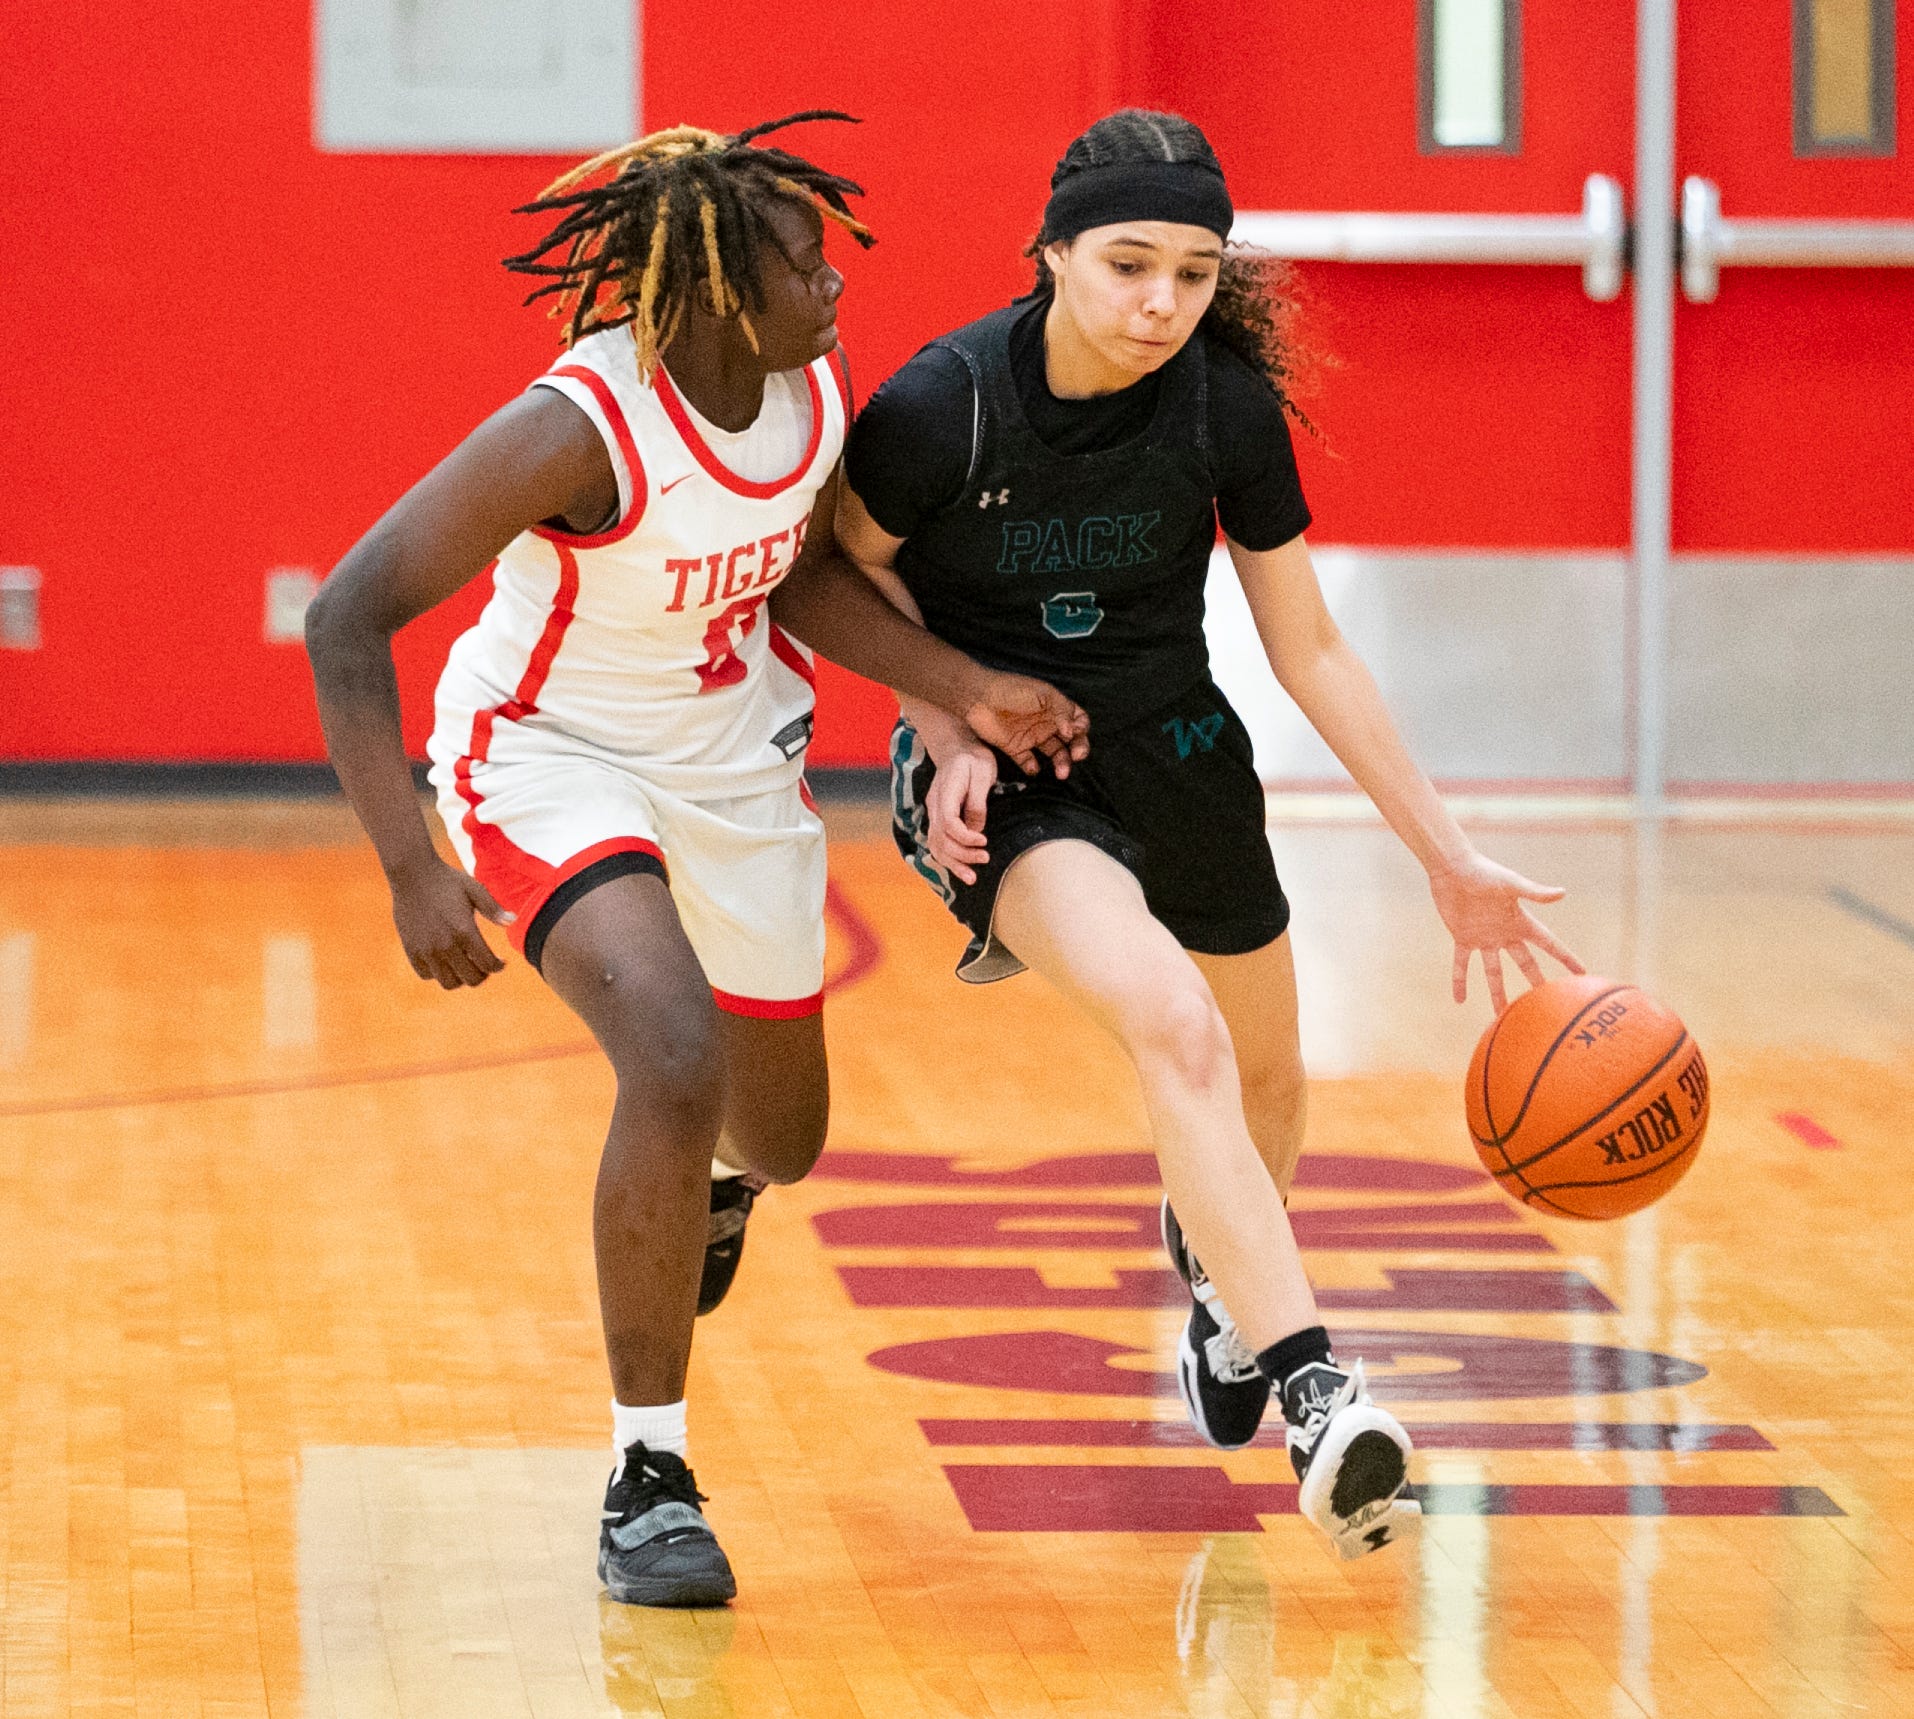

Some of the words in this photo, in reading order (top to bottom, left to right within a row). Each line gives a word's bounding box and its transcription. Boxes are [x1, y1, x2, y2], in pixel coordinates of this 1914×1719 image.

[997, 510, 1161, 574] PACK
[1574, 1001, 1628, 1050] ROCK
[1595, 1091, 1682, 1165] ROCK
